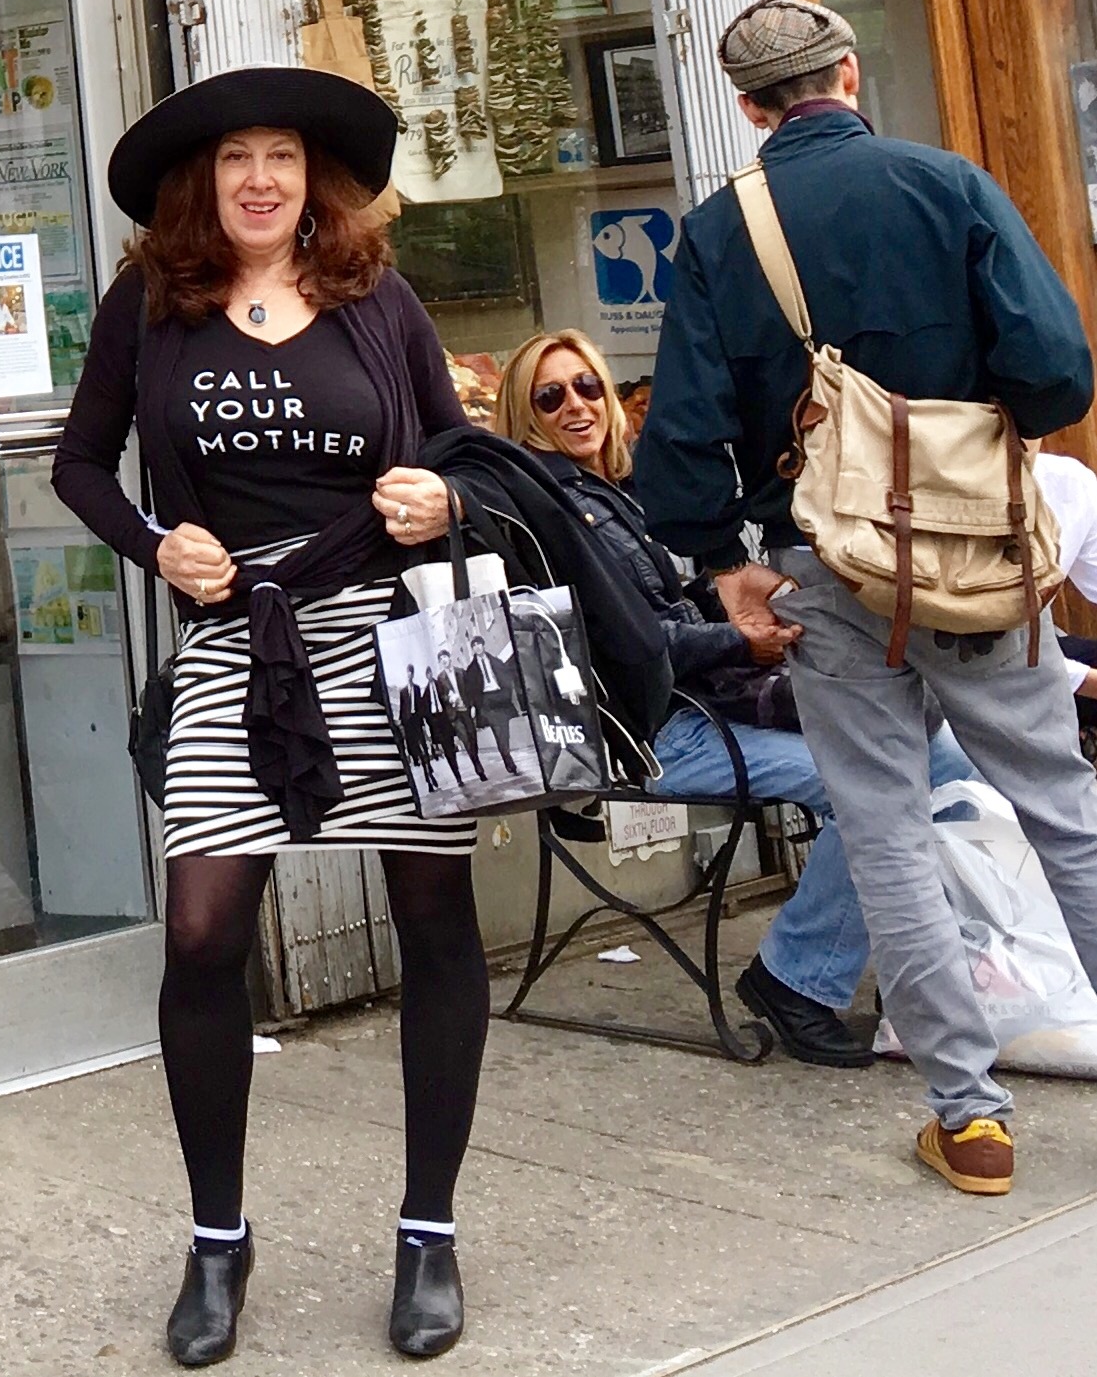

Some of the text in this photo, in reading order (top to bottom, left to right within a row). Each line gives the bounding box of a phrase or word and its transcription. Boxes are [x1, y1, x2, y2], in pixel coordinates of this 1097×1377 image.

[193, 369, 292, 390] CALL
[190, 397, 305, 422] YOUR
[196, 429, 365, 456] MOTHER
[623, 815, 676, 840] SIXTH FLOOR
